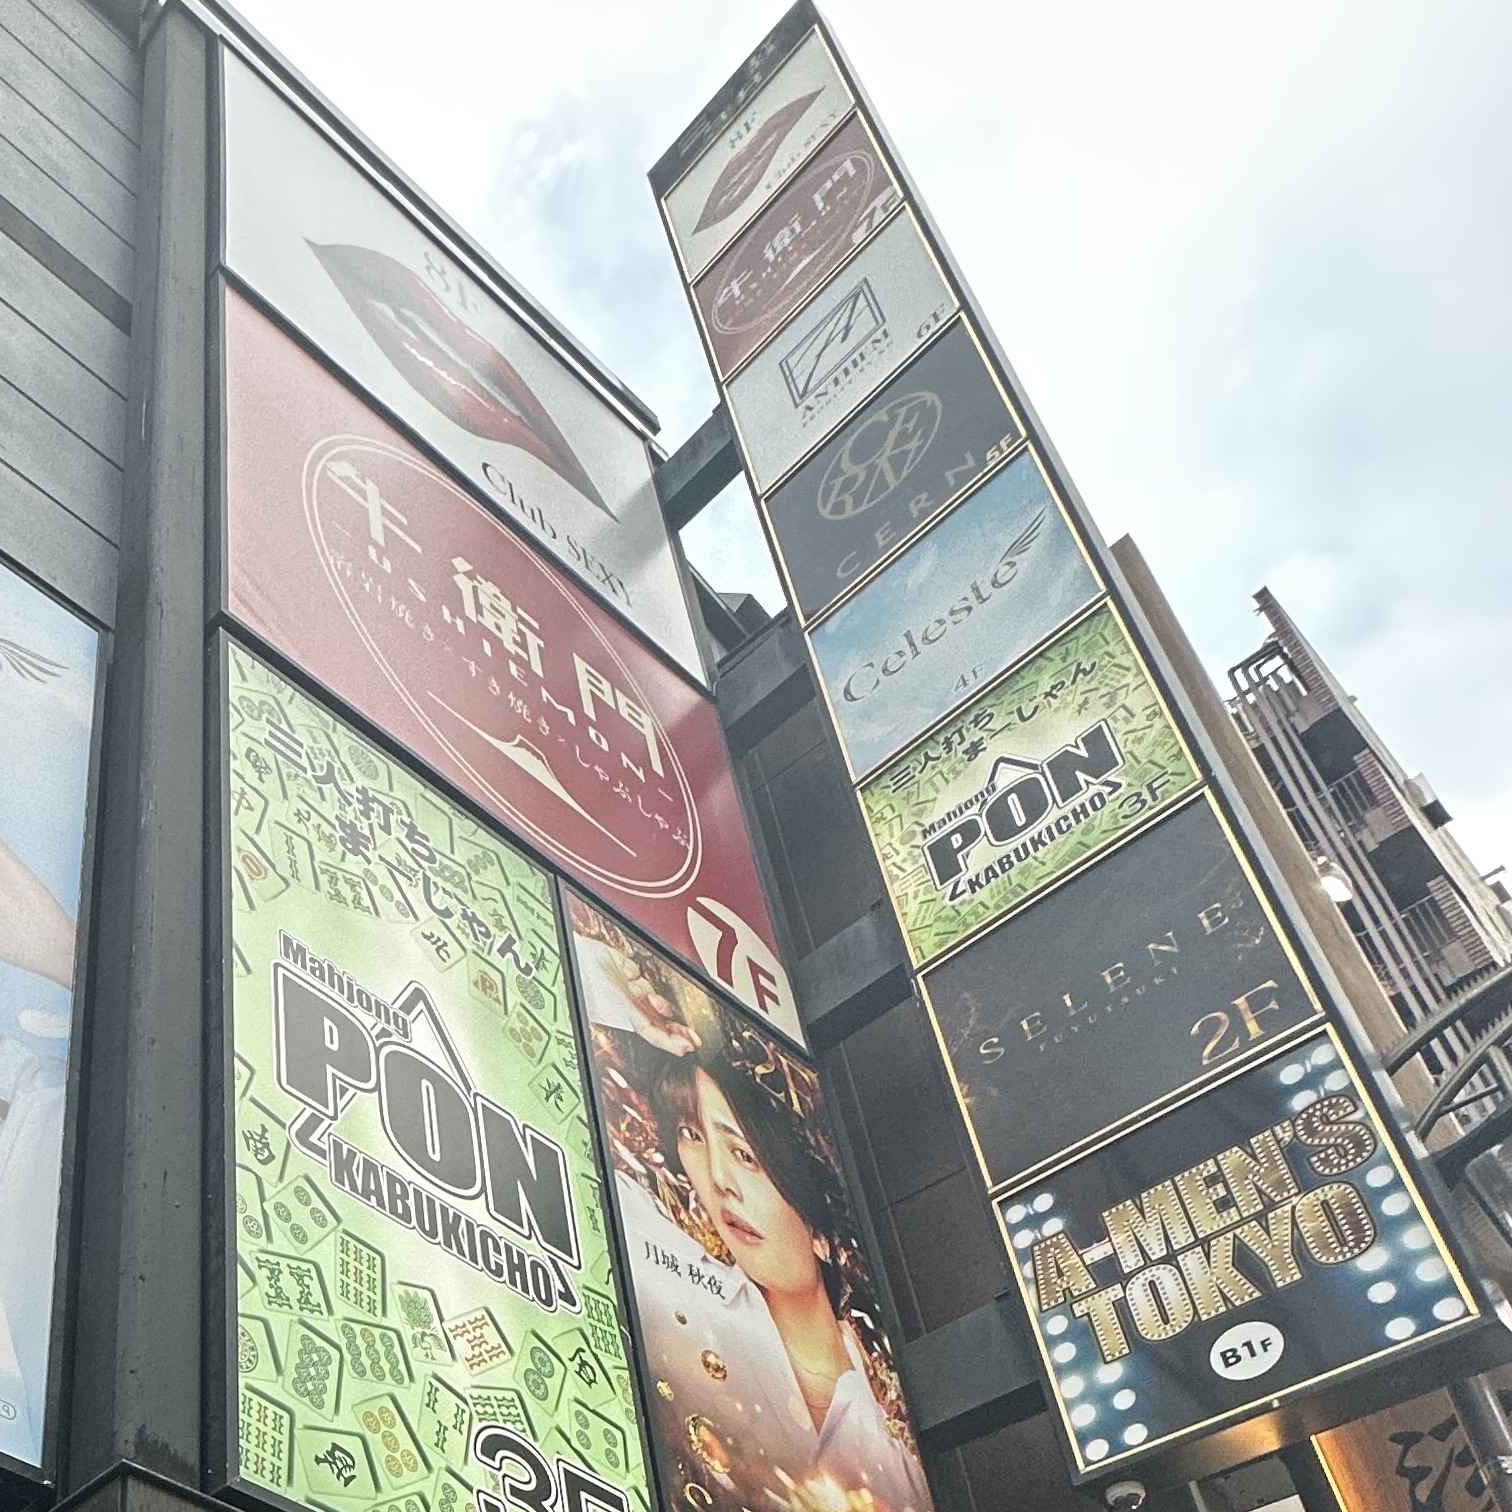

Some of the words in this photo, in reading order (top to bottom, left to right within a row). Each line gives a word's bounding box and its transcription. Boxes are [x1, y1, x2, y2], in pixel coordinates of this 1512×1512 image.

[837, 451, 975, 579] CERN
[326, 459, 665, 778] 牛衛門
[843, 558, 1020, 703] Celeste
[953, 663, 986, 693] 4F
[888, 707, 996, 793] 三人打ち
[961, 660, 1098, 763] まーじゃん
[262, 718, 438, 868] 三人打ち
[921, 719, 1125, 892] PON
[921, 781, 998, 840] Mahjong
[967, 790, 1108, 895] KABUKICHO
[1117, 771, 1173, 821] 3F
[335, 817, 535, 979] まーじゃん
[689, 899, 781, 1016] 7F
[278, 930, 412, 1041] Mahjong
[978, 901, 1230, 1065] SELENE
[1190, 978, 1281, 1066] 2F
[273, 962, 583, 1270] PON
[328, 1135, 563, 1312] KABUKICHO
[1031, 1094, 1376, 1313] A-MEN'S
[1072, 1181, 1378, 1365] TOKYO
[1219, 1336, 1275, 1369] B1F
